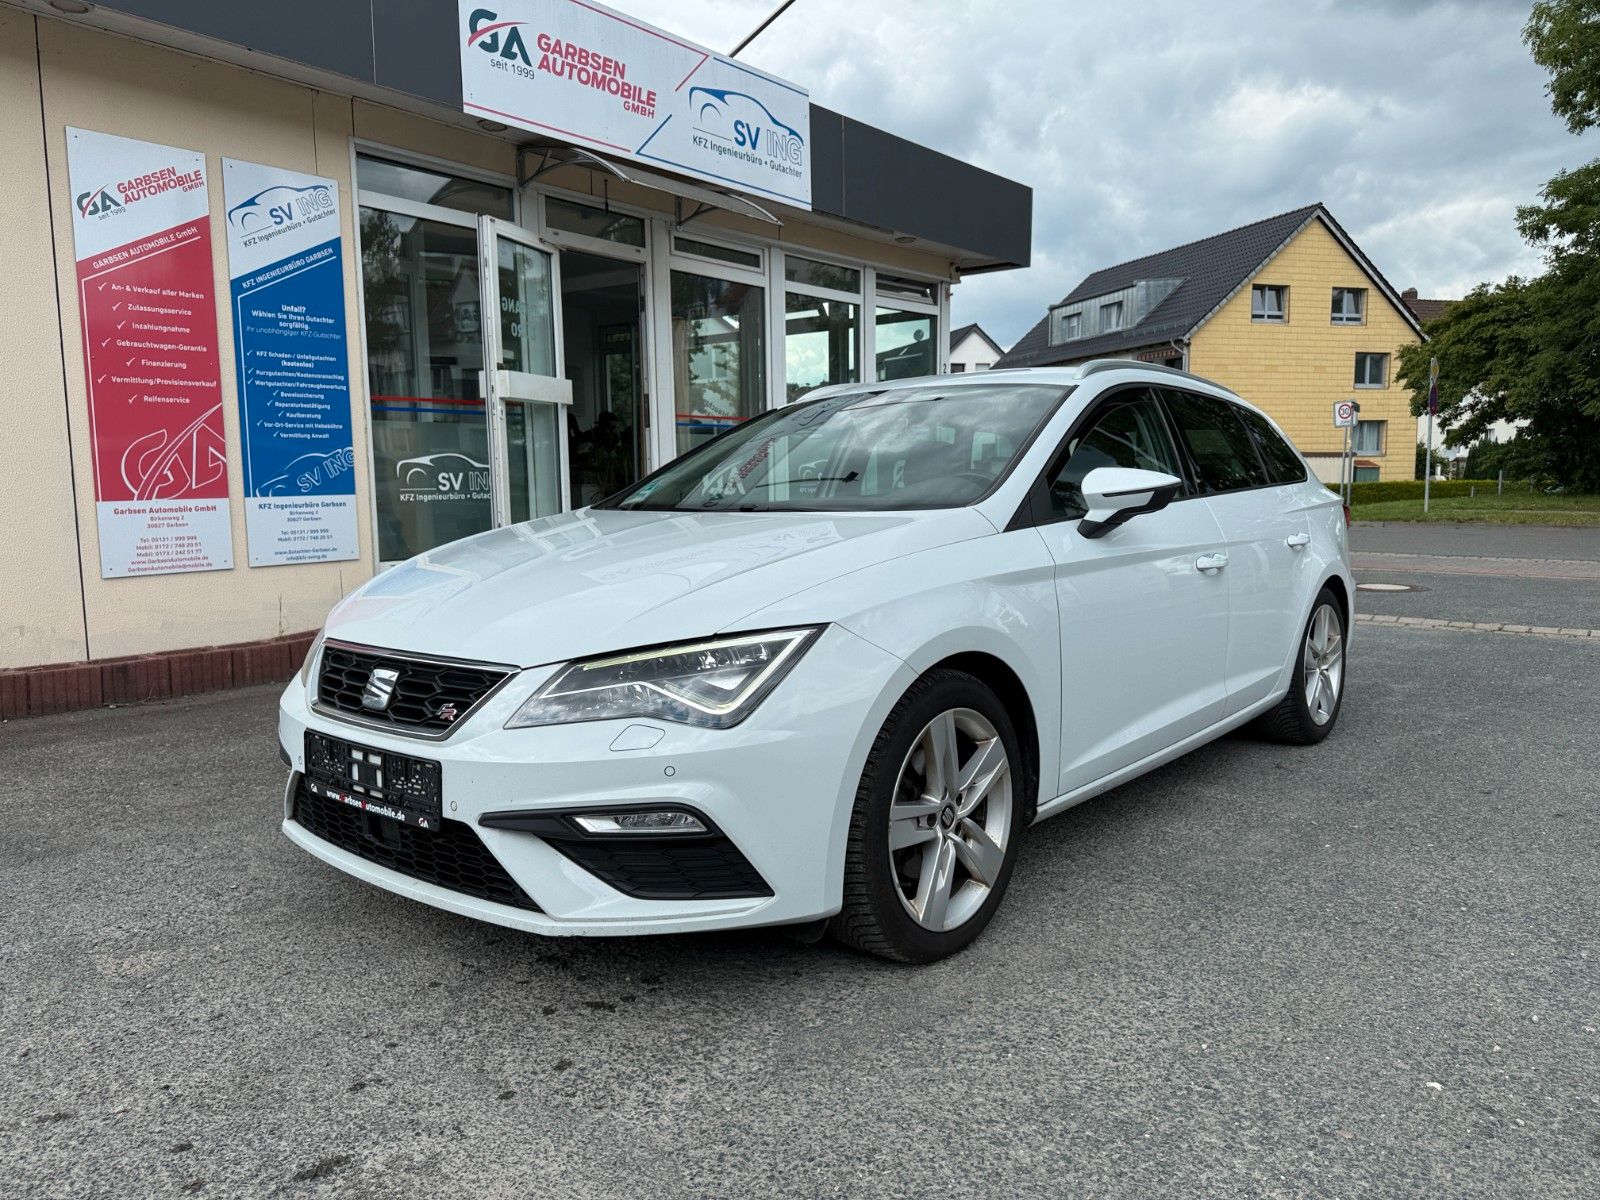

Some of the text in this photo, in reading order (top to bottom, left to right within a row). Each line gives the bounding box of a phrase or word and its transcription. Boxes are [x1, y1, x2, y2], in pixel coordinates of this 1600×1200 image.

[537, 33, 626, 79] GARBSEN
[490, 58, 535, 80] seit 1999
[537, 54, 656, 108] AUTOMOBILE
[623, 100, 655, 118] GMBH
[733, 119, 802, 166] SV ING
[692, 135, 802, 178] KFZ Ingenieurbüro Gutachter
[117, 166, 177, 193] GARBSEN
[124, 170, 203, 205] AUTOMOBILE
[182, 181, 205, 193] GMBH
[98, 206, 126, 220] seit 1999
[269, 189, 332, 225] SV ING
[243, 208, 336, 247] KFZ Ingenieurbüro Gutachter
[93, 226, 198, 269] GARBSEN AUTOMOBILE GmbH
[242, 247, 333, 289] KFZ INGENIEURBÜRO GARBSEN
[133, 286, 160, 295] Verkauf
[162, 289, 177, 297] aller
[179, 291, 204, 299] Marken
[128, 303, 192, 316] Zulassungsservice
[281, 304, 306, 313] Unfall?
[251, 310, 276, 318] Wählen
[289, 313, 305, 321] Ihren
[306, 315, 335, 324] Gutachter
[132, 322, 190, 333] Inzahlungnahme
[279, 321, 311, 330] sorgfältig.
[301, 331, 341, 339] KFZ-Gutachter
[117, 340, 207, 352] Gebrauchtwagen-Garantie
[142, 360, 187, 369] Finanzierung
[281, 360, 314, 368] (kostenlos)
[111, 375, 216, 387] Vermittlung/Provisionsverkauf
[144, 395, 190, 404] Reifenservice
[297, 466, 321, 492] SV
[438, 471, 490, 491] SV IN
[400, 493, 414, 501] KFZ
[416, 492, 465, 502] Ingenieurbüro
[149, 505, 192, 514] Automobile
[274, 501, 320, 510] Ingenieurbüro
